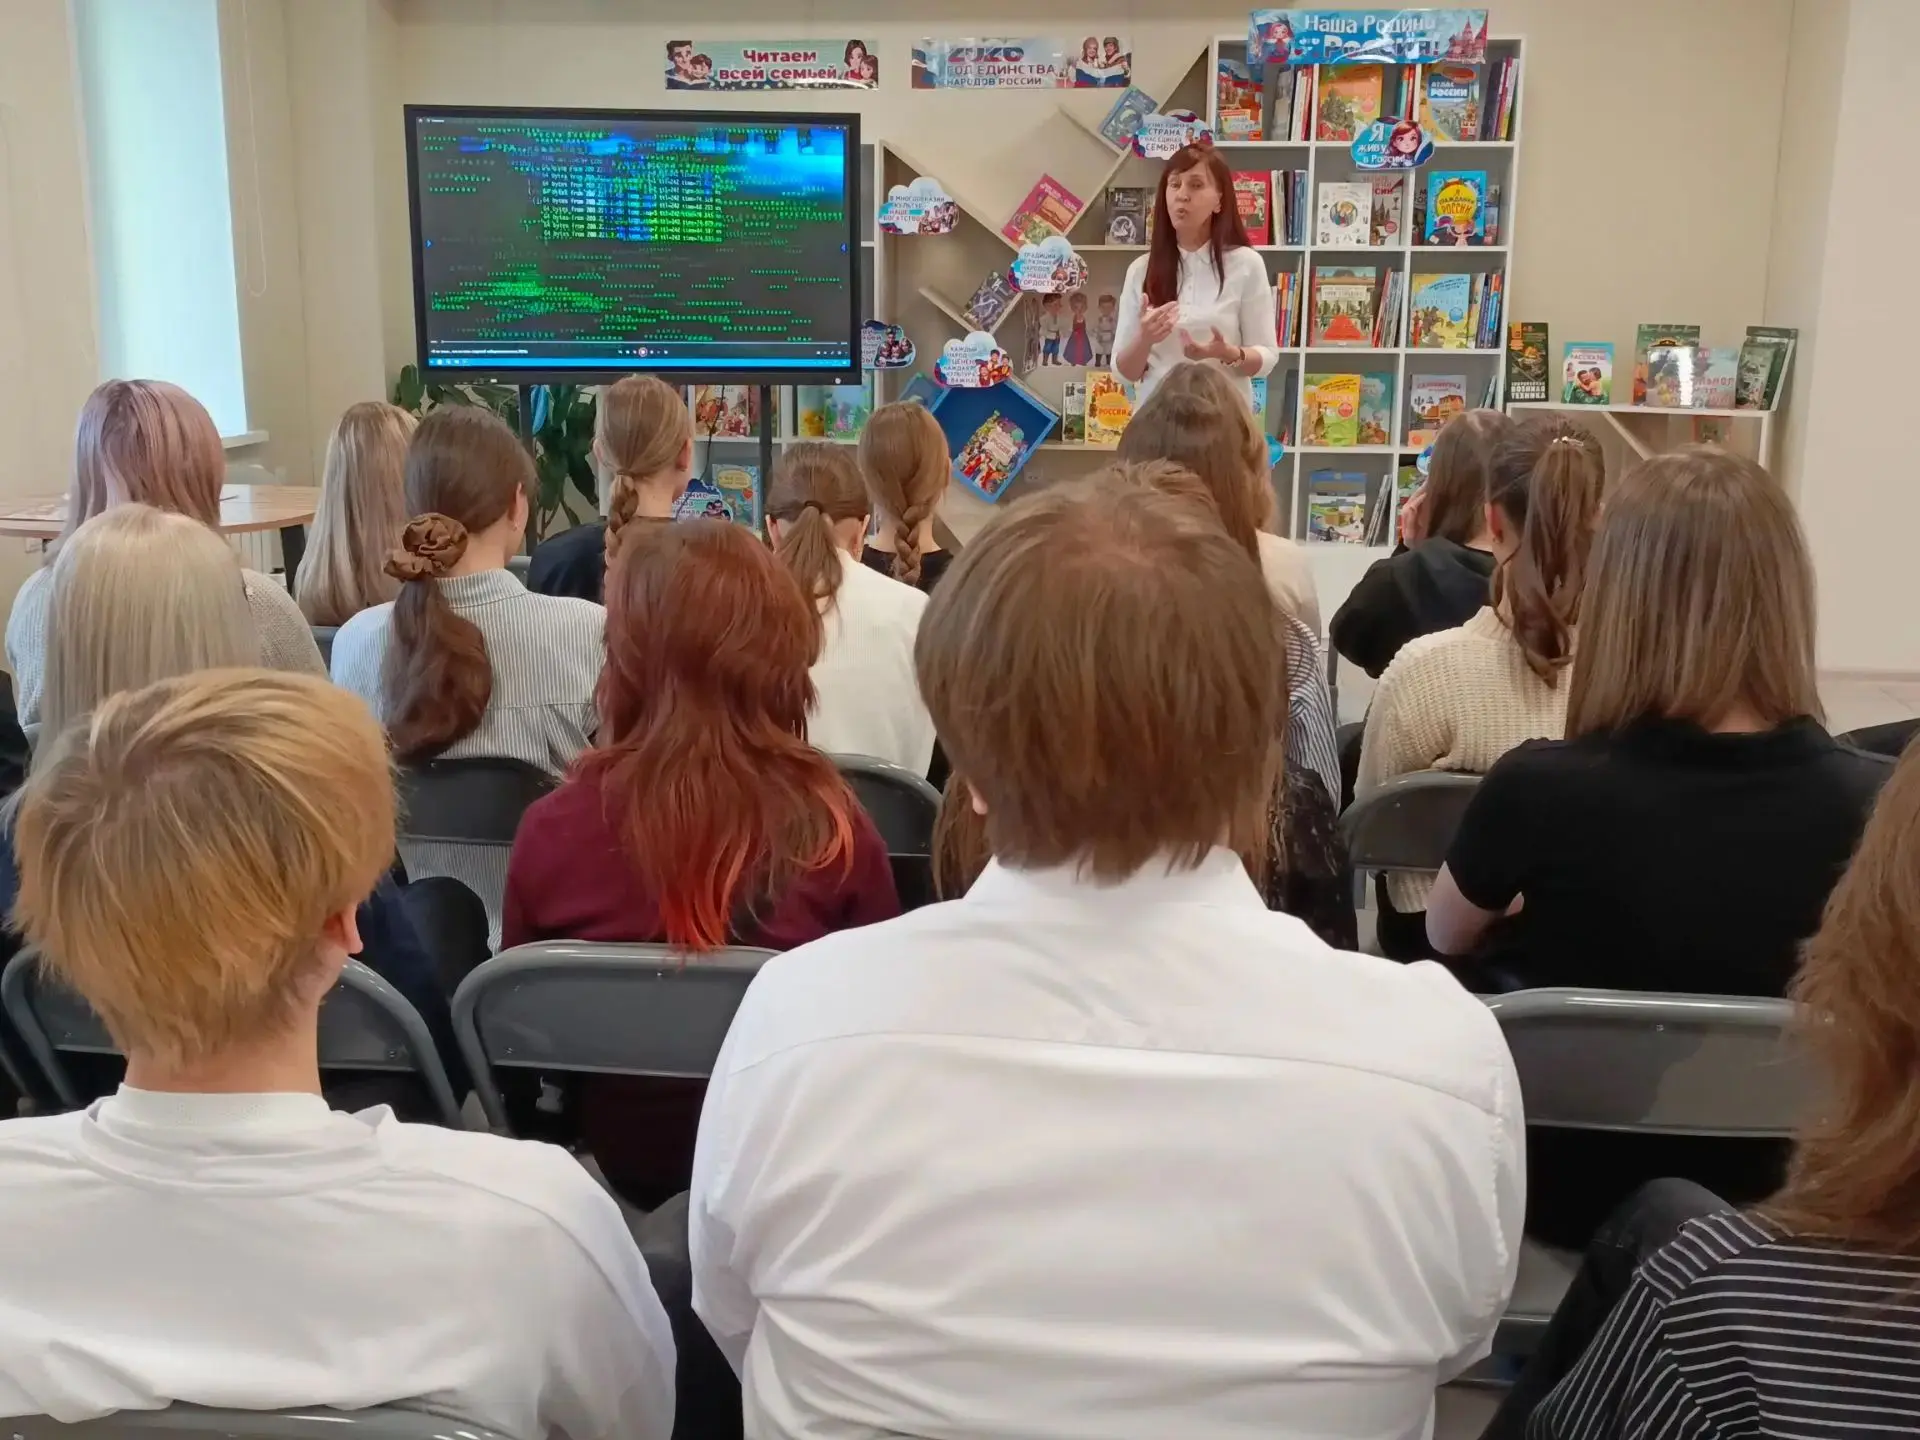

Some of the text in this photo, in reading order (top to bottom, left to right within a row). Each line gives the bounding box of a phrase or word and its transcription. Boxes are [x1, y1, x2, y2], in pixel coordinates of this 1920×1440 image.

[1304, 14, 1357, 33] Наша
[743, 49, 817, 63] Читаем
[718, 65, 838, 80] всей семьей
[947, 64, 1057, 77] ГОД ЕДИНСТВА
[947, 77, 1042, 87] НАРОДОВ РОССИИ
[1369, 122, 1385, 142] Я
[1511, 392, 1546, 400] ТЕХНИКА
